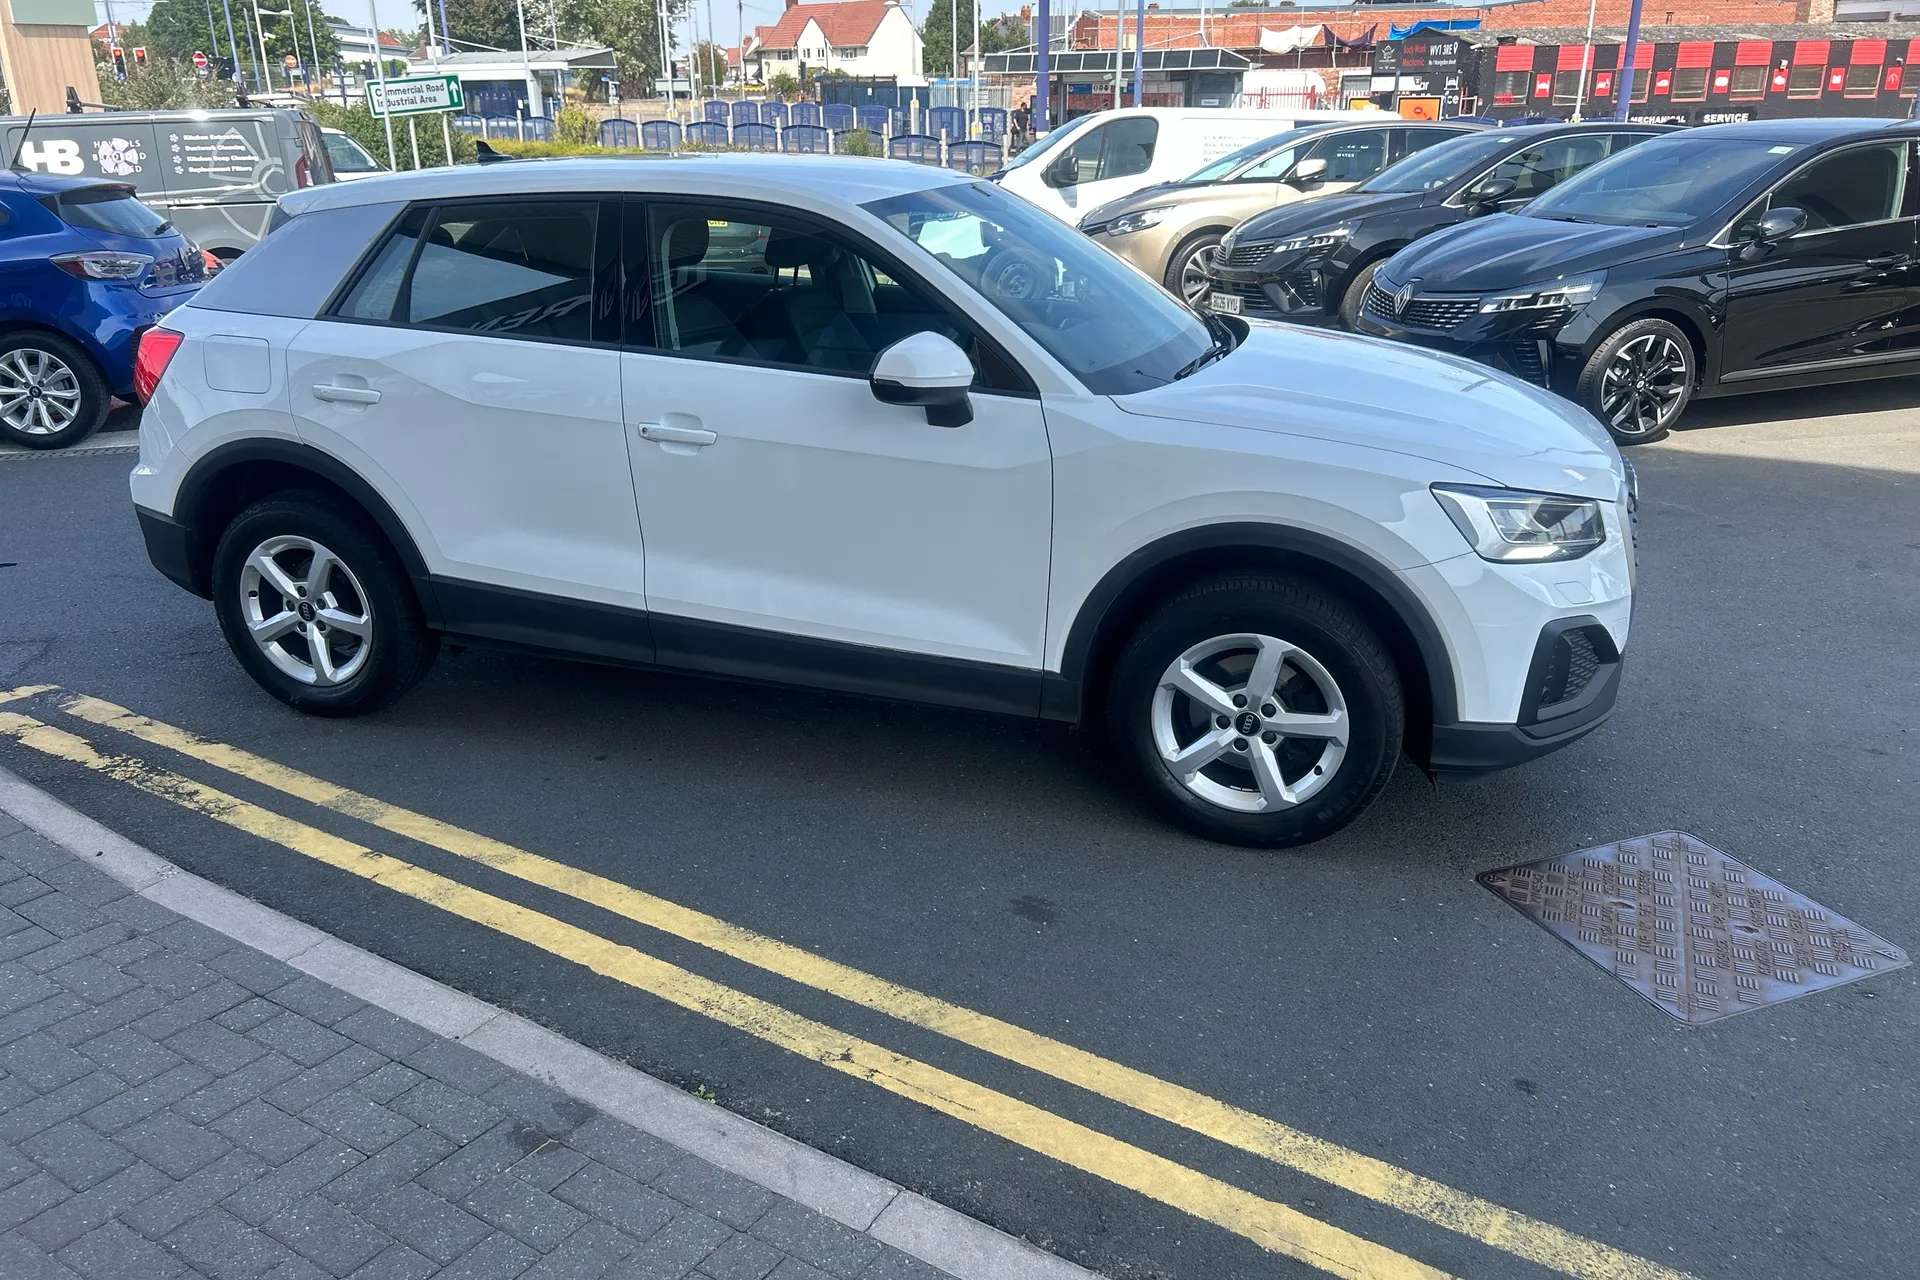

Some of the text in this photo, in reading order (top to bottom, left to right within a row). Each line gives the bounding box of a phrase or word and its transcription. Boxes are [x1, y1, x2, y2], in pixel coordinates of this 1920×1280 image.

[375, 83, 445, 97] Cmmercial Road
[420, 95, 437, 104] Area
[1703, 112, 1749, 123] SERVICE
[20, 139, 85, 175] HB
